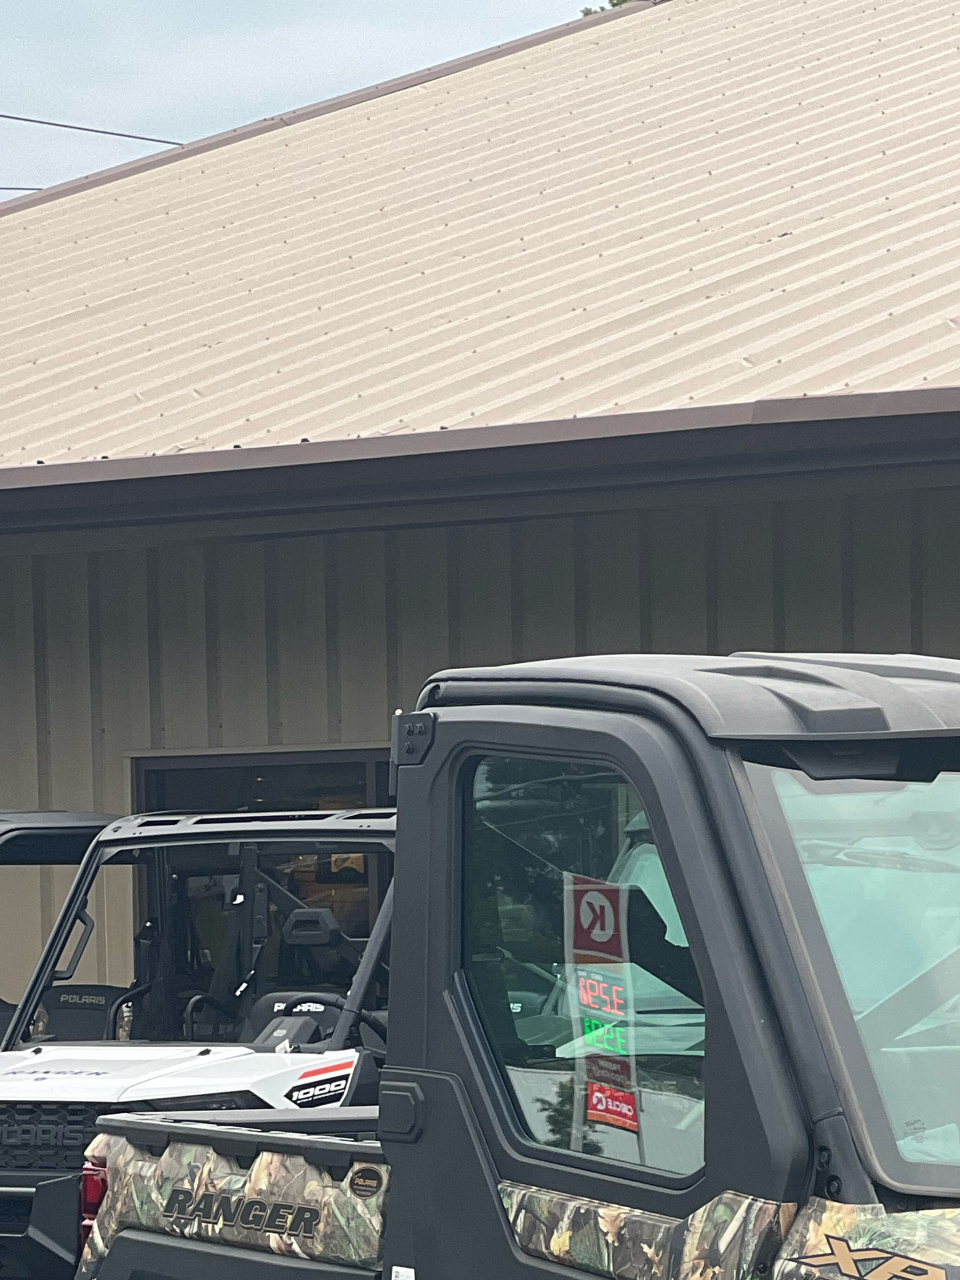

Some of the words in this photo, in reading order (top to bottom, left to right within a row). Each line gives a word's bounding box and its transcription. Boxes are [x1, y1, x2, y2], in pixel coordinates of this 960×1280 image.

[60, 994, 106, 1004] POLARIS
[273, 1002, 325, 1013] PARIS
[291, 1080, 347, 1101] 1000
[163, 1187, 320, 1239] RANGER
